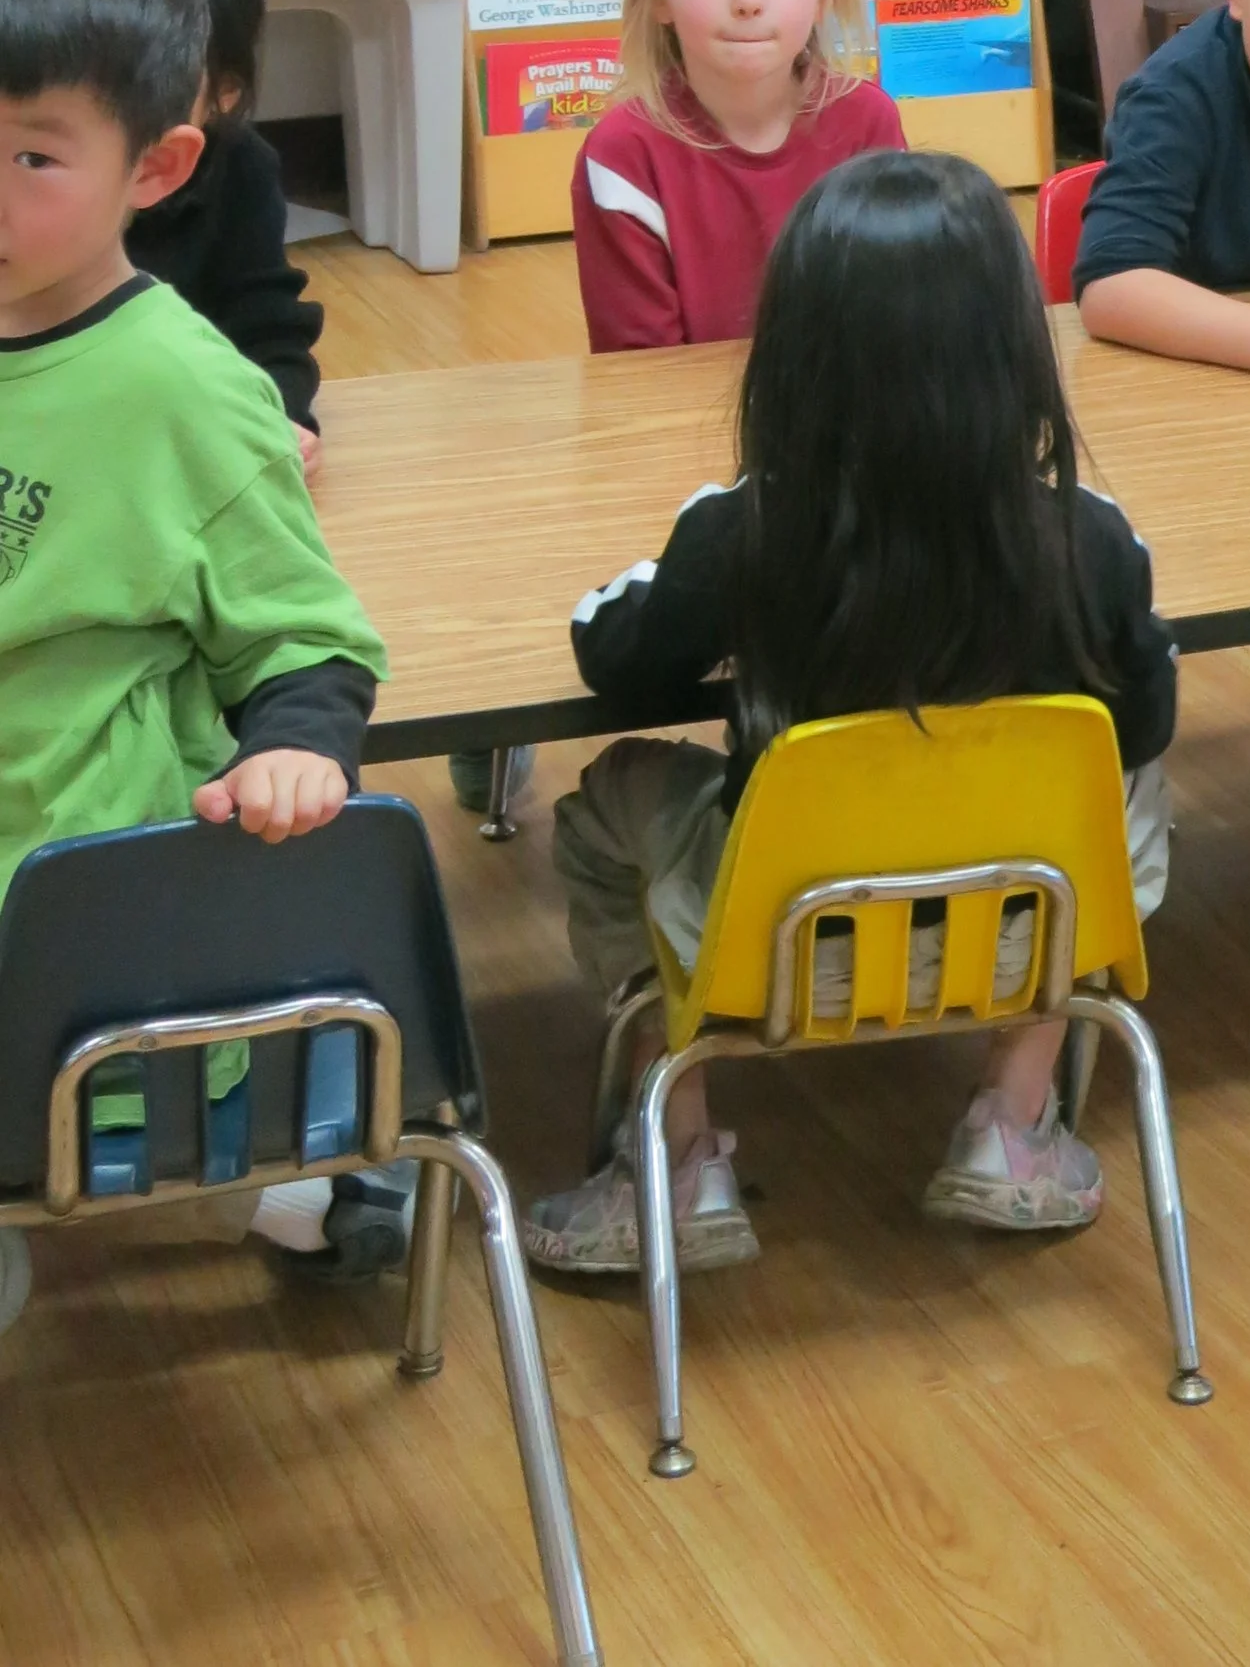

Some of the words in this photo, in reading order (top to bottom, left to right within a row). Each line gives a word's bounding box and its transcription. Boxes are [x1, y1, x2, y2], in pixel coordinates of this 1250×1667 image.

[478, 7, 535, 24] George
[536, 1, 622, 19] Washingto
[527, 61, 592, 81] Prayers
[534, 76, 575, 97] Avail
[579, 75, 614, 92] Muc
[552, 93, 607, 115] kids
